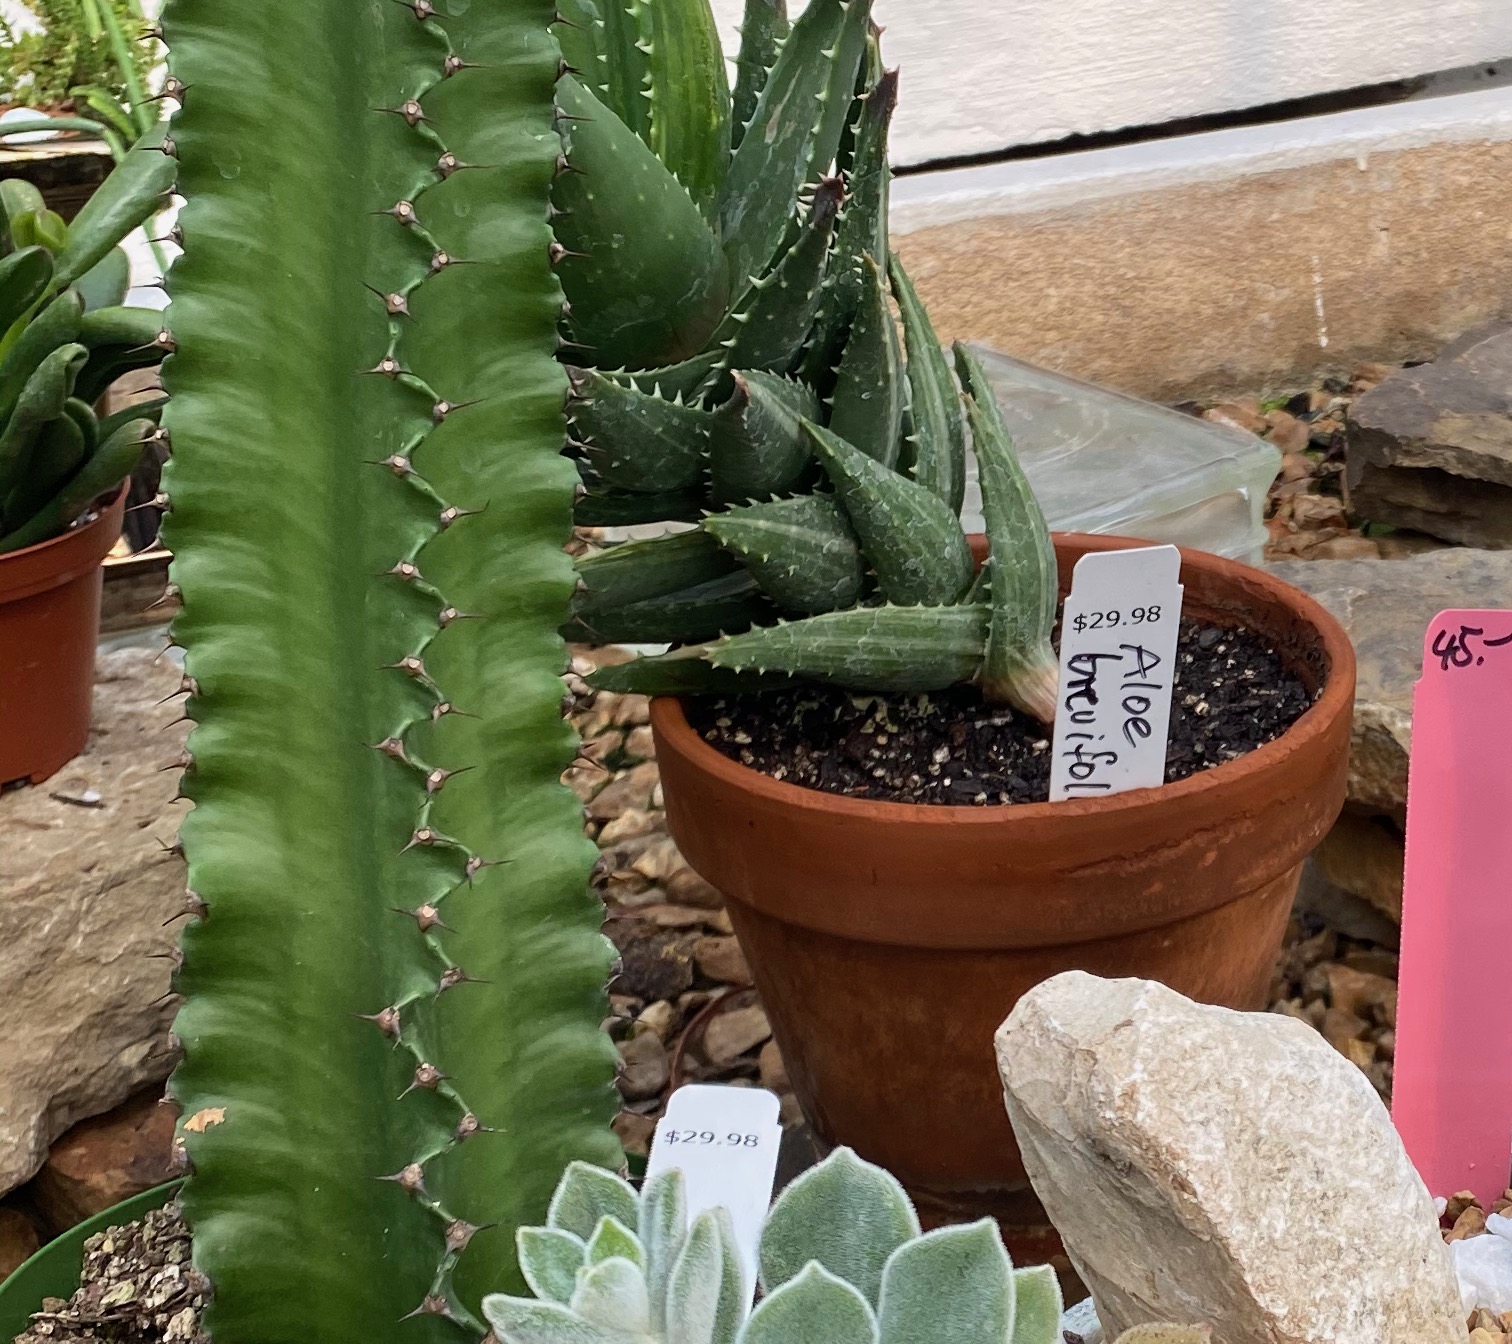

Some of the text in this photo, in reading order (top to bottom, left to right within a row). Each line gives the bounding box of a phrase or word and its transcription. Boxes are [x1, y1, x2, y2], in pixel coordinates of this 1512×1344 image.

[1072, 605, 1162, 634] $29.98
[1119, 643, 1163, 748] Aloe
[664, 1129, 759, 1148] $29.98
